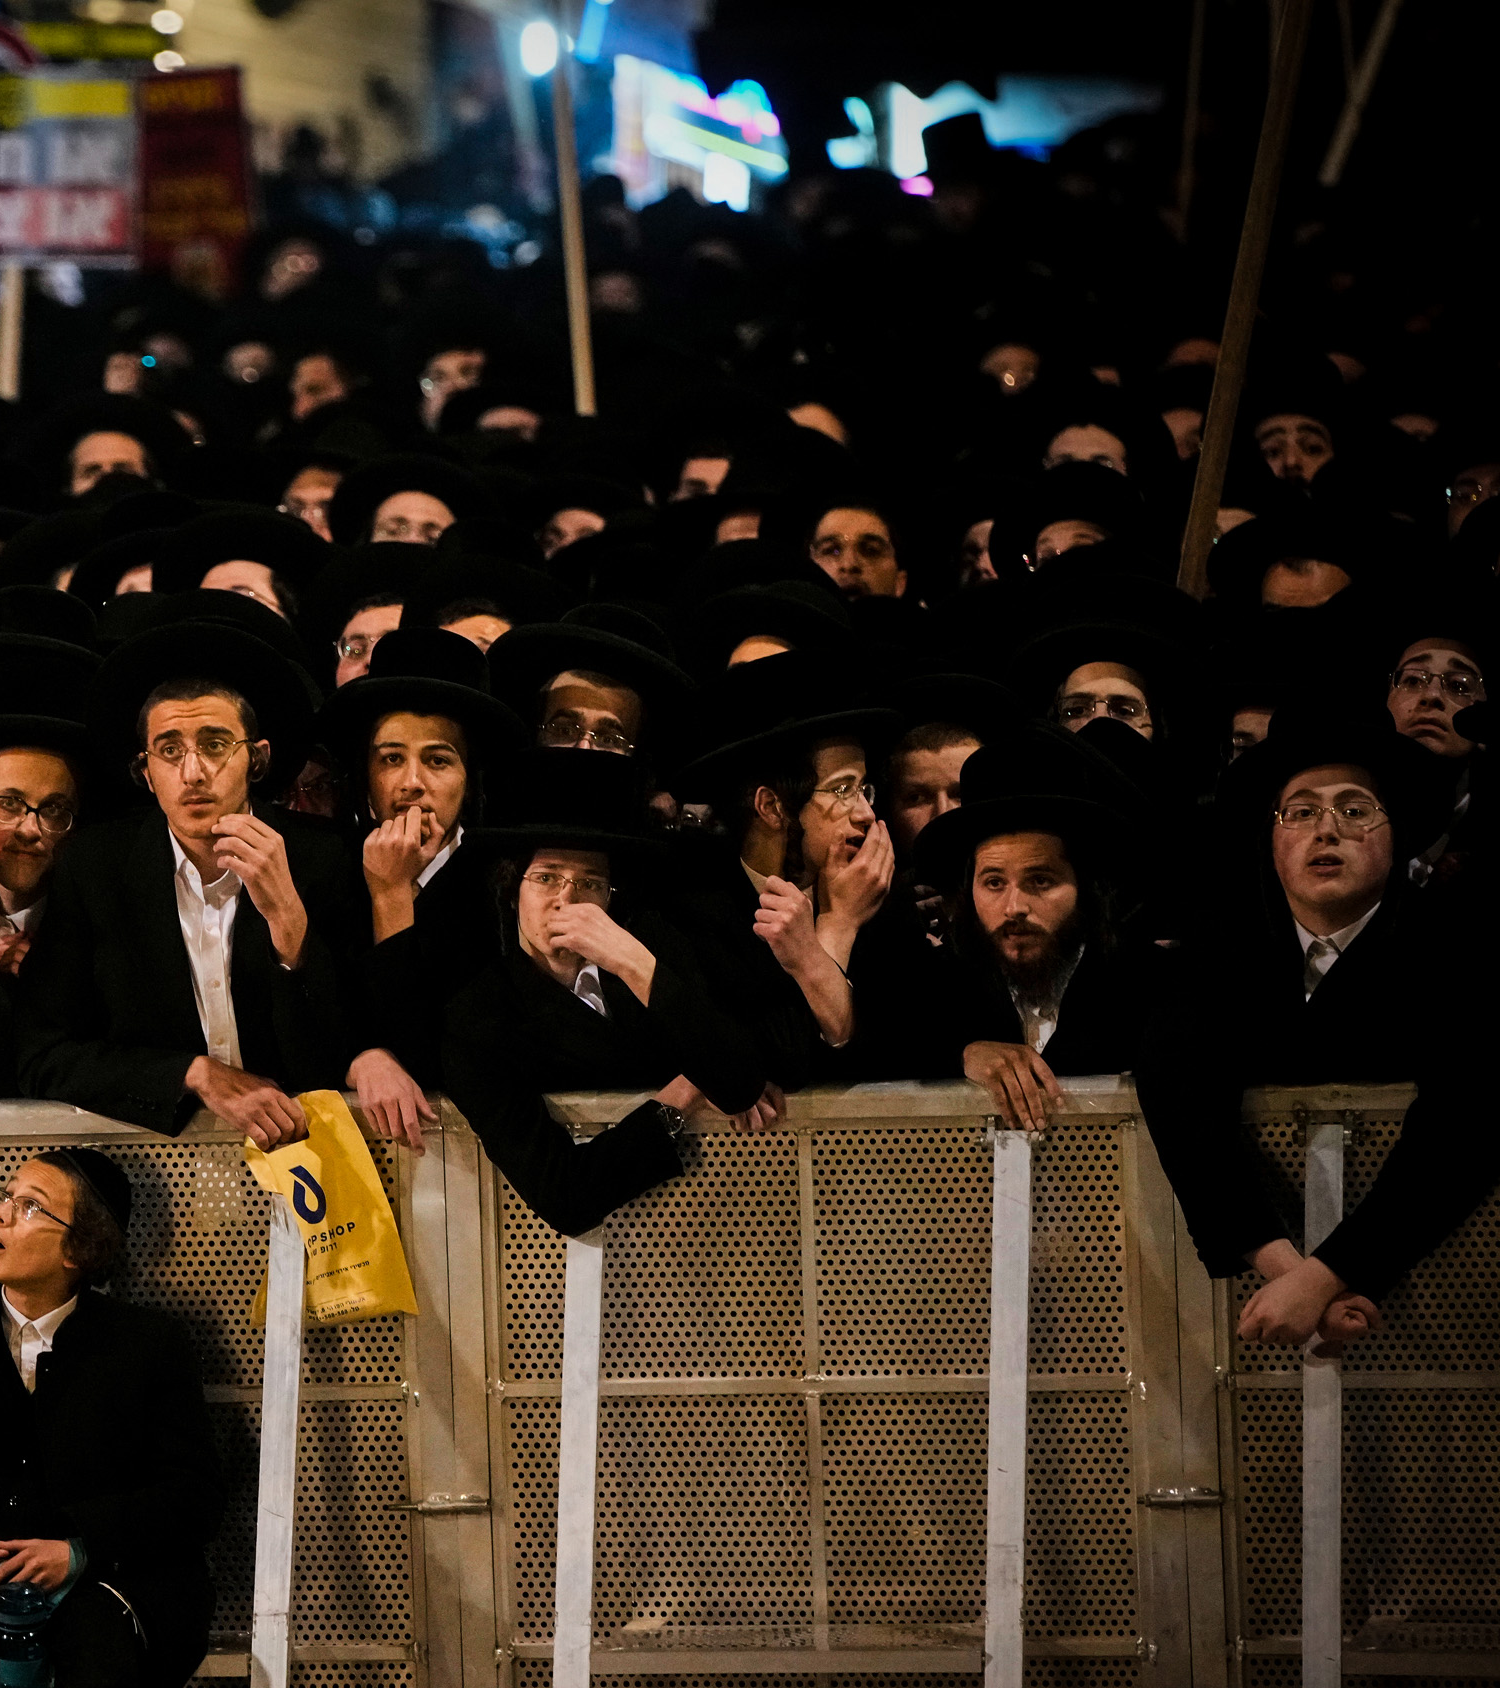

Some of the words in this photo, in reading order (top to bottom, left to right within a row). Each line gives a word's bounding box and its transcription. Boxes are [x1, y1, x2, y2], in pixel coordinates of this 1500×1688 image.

[52, 130, 126, 184] או
[50, 192, 118, 246] או
[320, 1221, 356, 1242] SHOP
